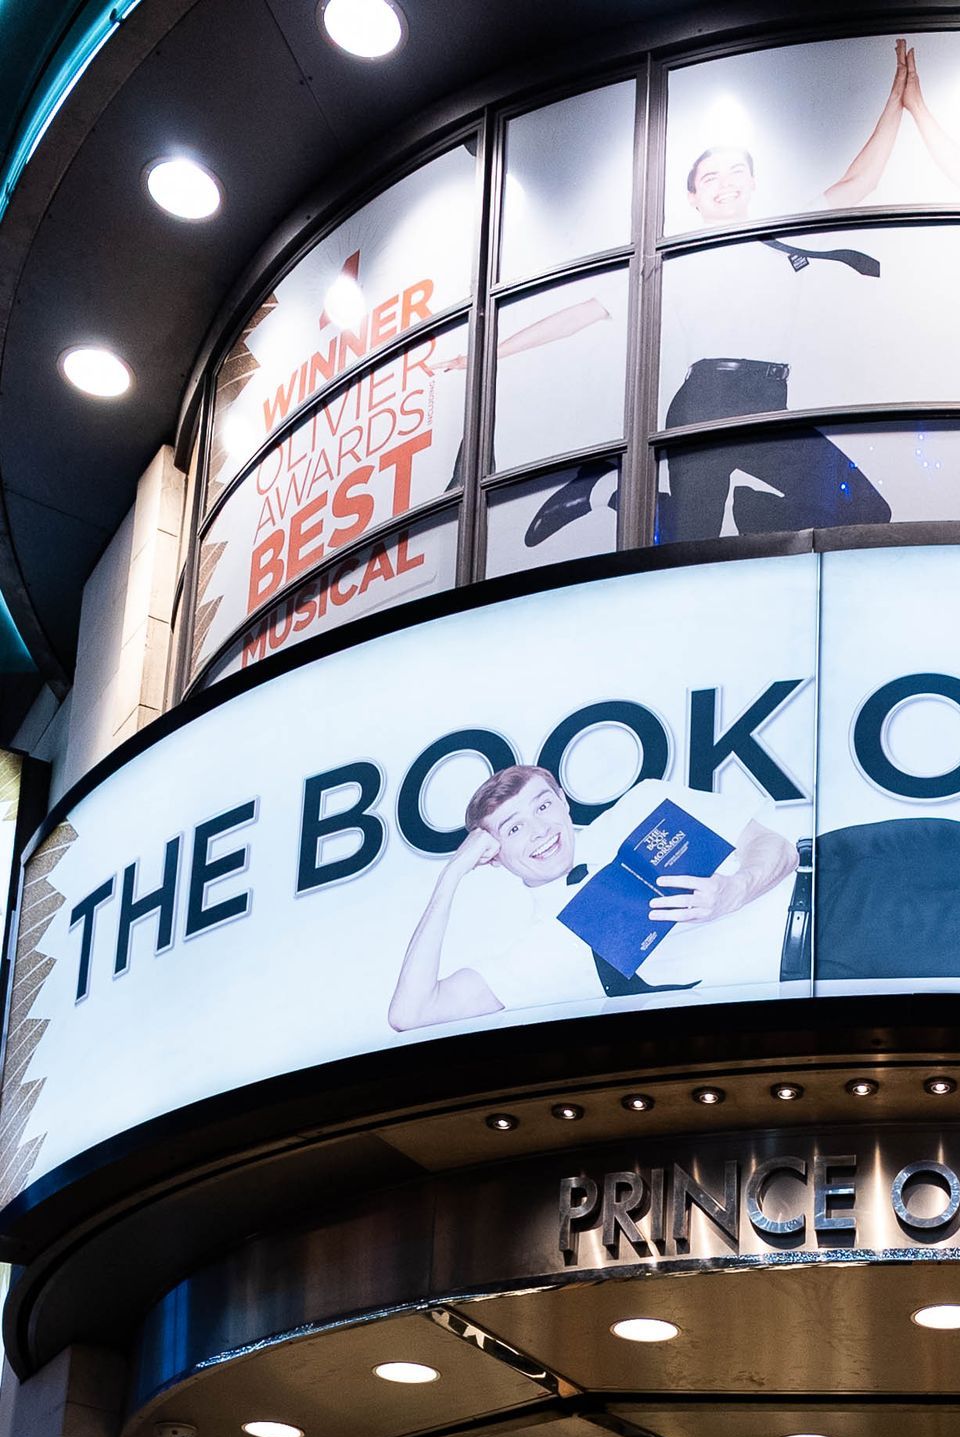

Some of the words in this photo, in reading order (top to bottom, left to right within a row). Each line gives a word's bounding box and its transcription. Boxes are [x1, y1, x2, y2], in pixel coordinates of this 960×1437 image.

[263, 279, 434, 433] WINNER
[247, 429, 432, 616] BEST
[253, 389, 424, 545] AWARDS
[241, 526, 425, 669] MUSICAL
[68, 795, 261, 1005] THE
[294, 676, 815, 898] BOOK
[644, 827, 661, 844] THE
[646, 829, 669, 851] BOOK
[650, 830, 686, 866] MORMON
[557, 1155, 859, 1256] PRINCE
